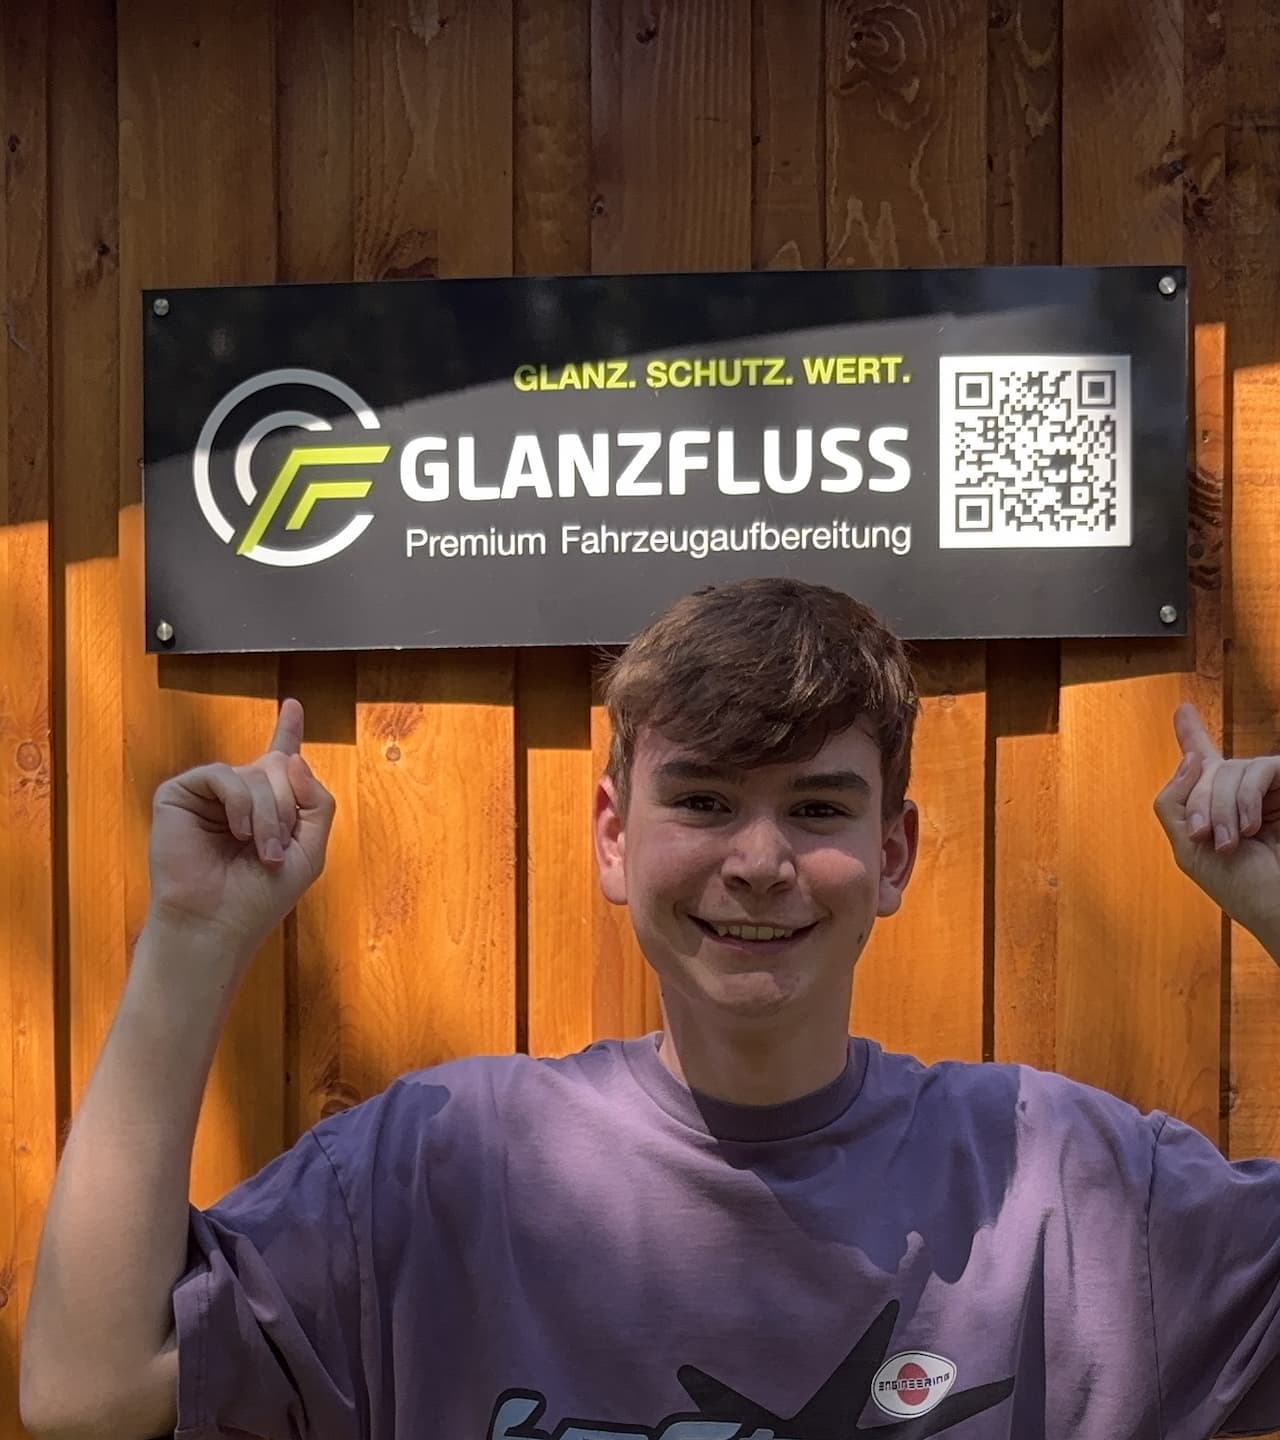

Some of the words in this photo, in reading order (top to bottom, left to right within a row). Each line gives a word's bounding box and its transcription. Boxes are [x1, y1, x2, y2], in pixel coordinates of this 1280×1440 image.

[513, 361, 637, 391] GLANZ.
[646, 357, 794, 388] SCHUTZ.
[803, 355, 912, 385] WERT.
[399, 426, 912, 503] GLANZFLUSS
[406, 528, 547, 558] Premium
[561, 522, 912, 559] Fahrzeugaufbereitung
